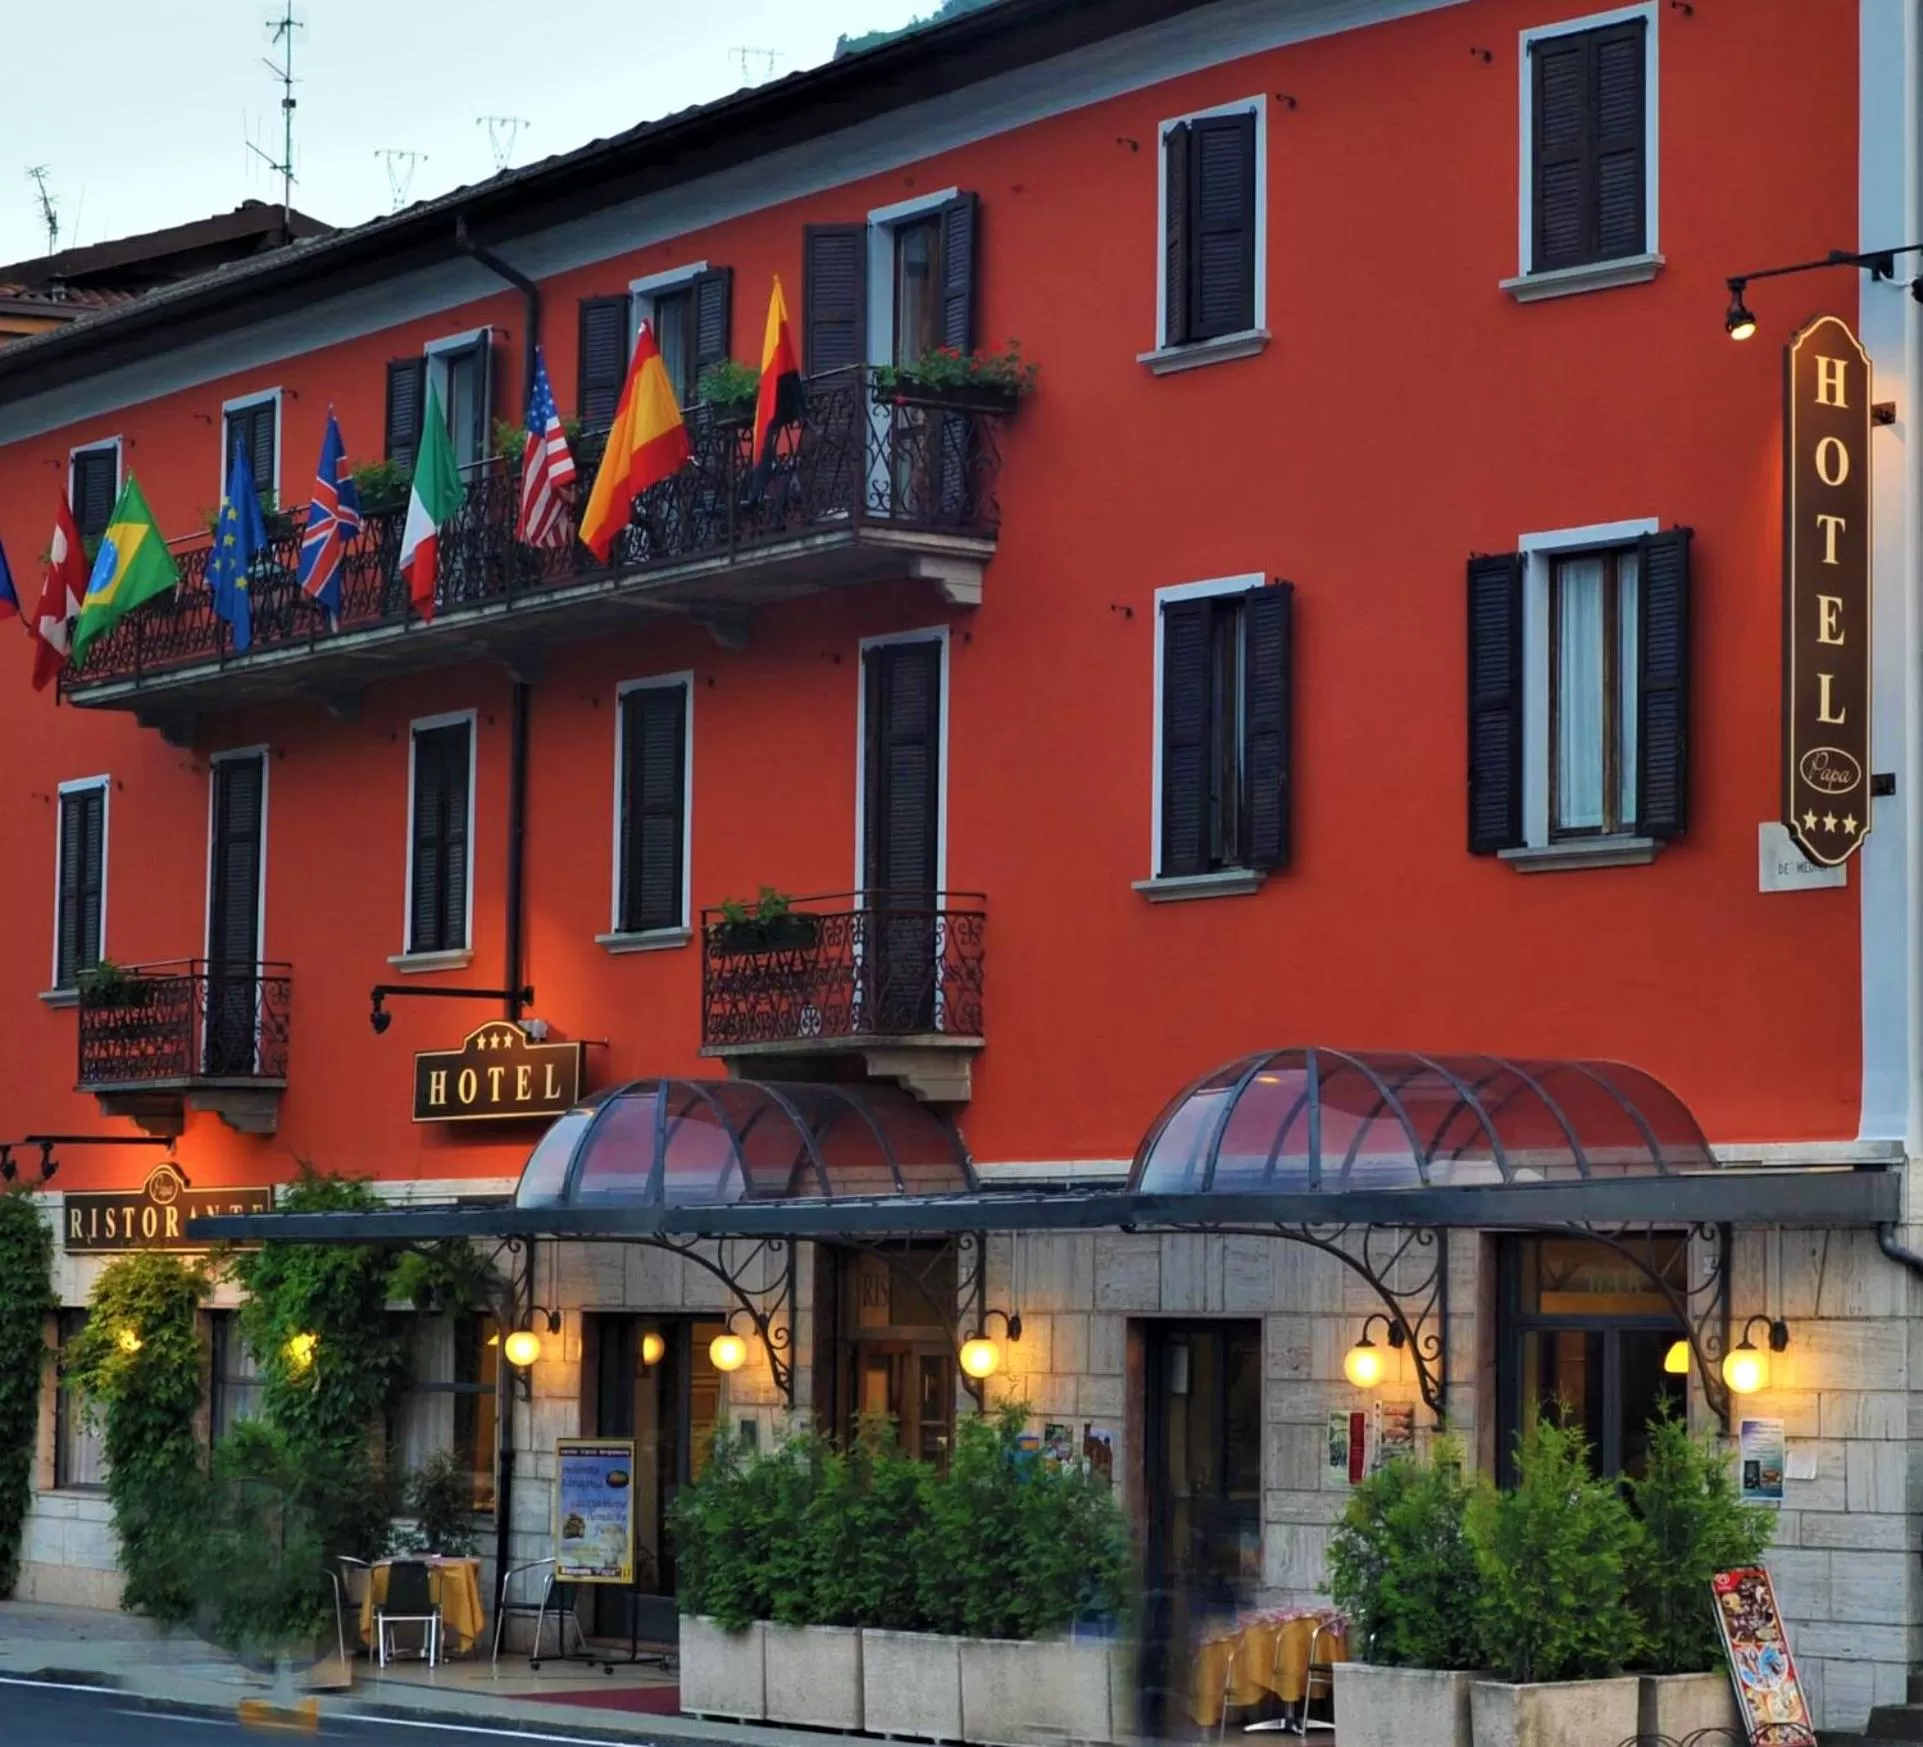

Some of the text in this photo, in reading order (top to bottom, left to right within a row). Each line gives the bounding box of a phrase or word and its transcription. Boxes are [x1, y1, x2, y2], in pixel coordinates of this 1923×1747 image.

[1814, 355, 1849, 725] HOTEL
[1808, 751, 1851, 791] Papa
[429, 1064, 561, 1105] HOTEL
[70, 1204, 264, 1238] RISTOR
